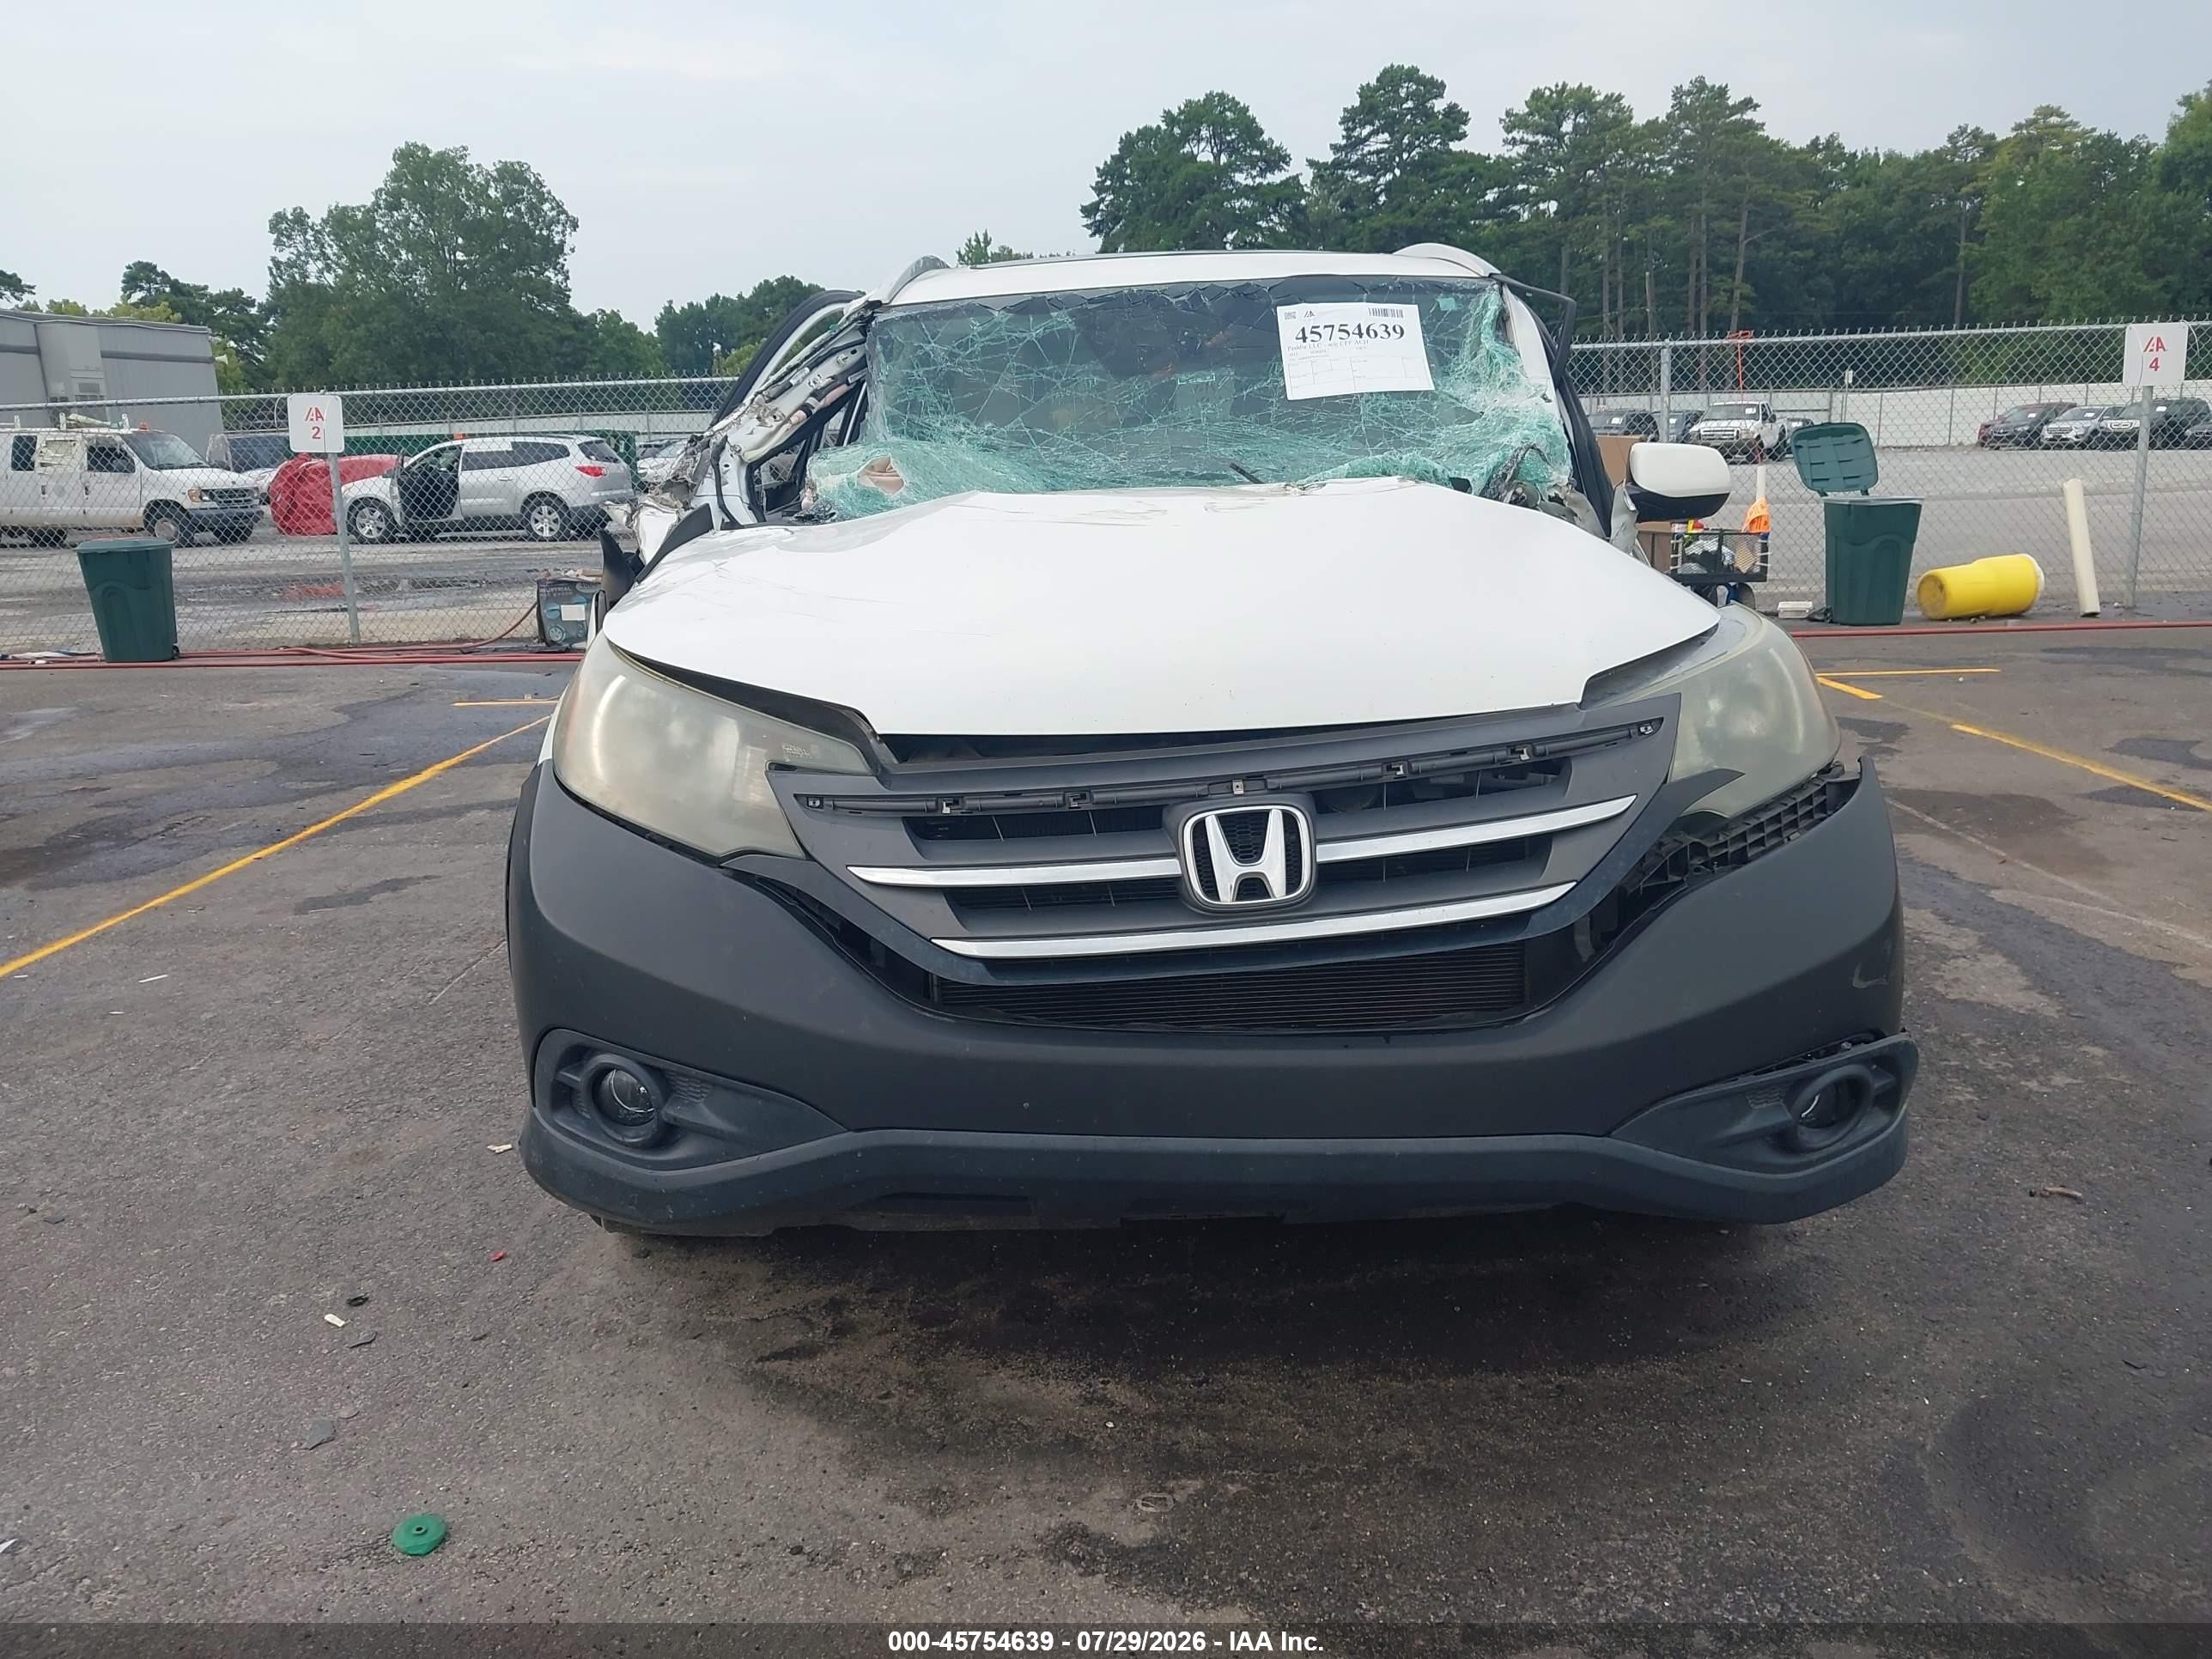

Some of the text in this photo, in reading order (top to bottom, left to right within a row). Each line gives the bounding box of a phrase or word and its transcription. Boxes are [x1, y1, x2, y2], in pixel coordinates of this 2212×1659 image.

[1295, 322, 1405, 343] 45754639
[2148, 356, 2160, 372] 4
[311, 426, 322, 440] 2
